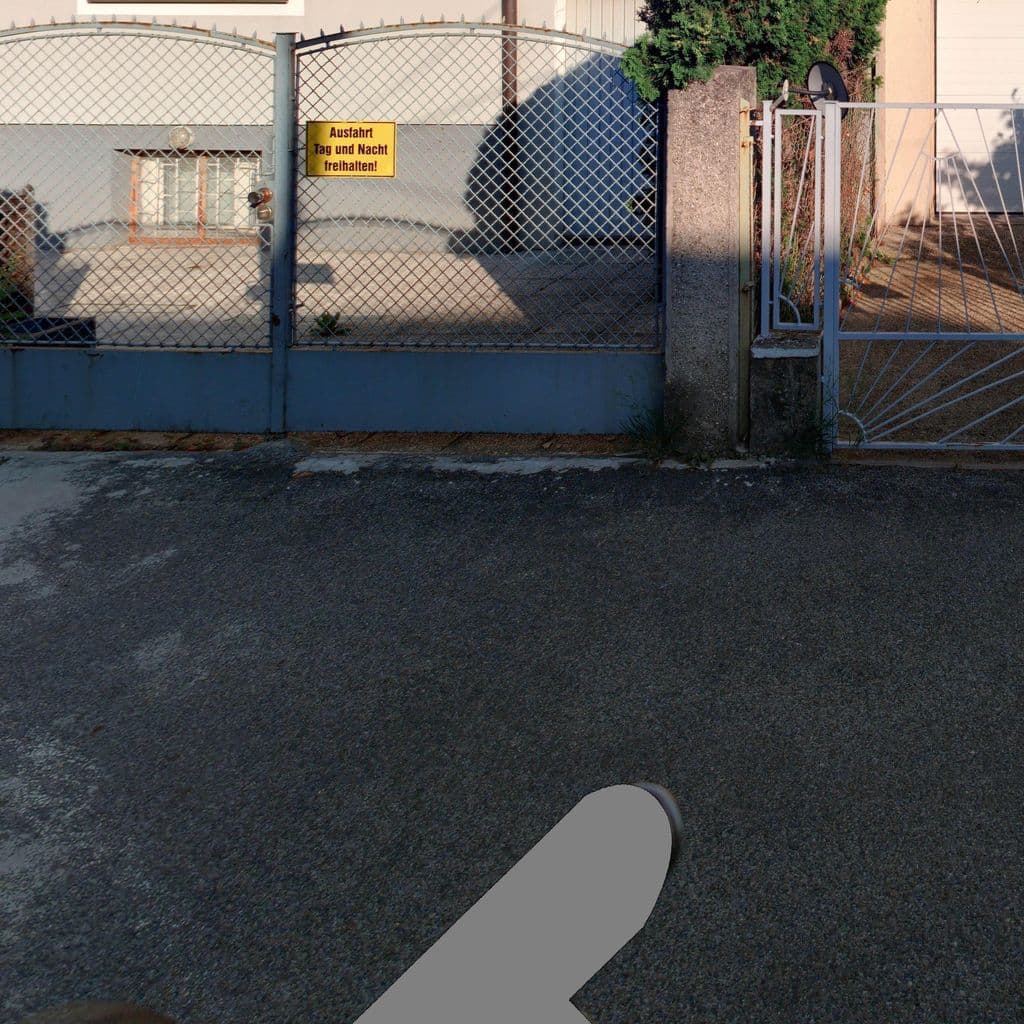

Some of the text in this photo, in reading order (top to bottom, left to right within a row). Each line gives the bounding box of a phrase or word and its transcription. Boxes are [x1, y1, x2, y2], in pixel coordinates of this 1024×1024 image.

[330, 127, 373, 138] Ausfahrt
[313, 144, 388, 156] Tag und Nacht
[324, 160, 377, 172] freihalten!
